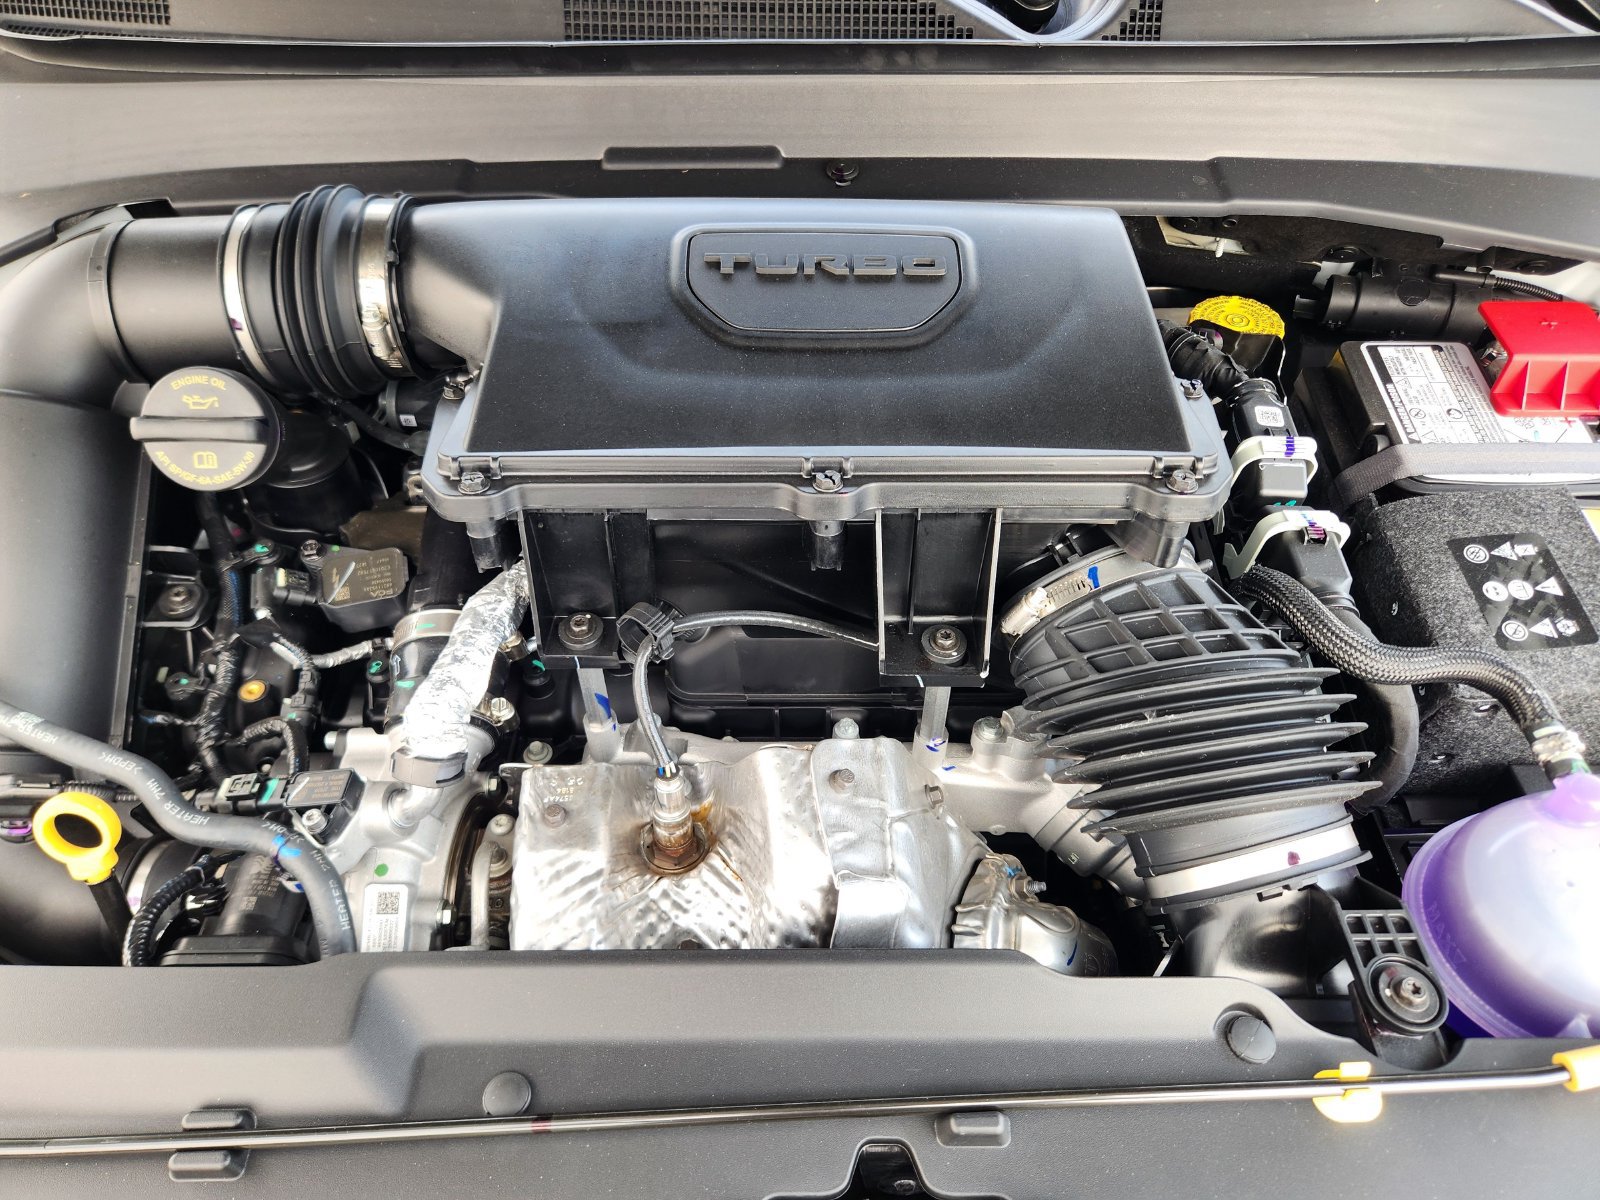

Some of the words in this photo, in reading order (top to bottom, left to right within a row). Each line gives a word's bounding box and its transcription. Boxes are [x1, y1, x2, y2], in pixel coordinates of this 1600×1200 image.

[703, 252, 947, 276] TURBO
[170, 375, 209, 390] ENGINE
[211, 377, 227, 390] OIL
[370, 588, 393, 598] FCA
[163, 800, 210, 825] HEATER
[329, 879, 351, 930] HEATER
